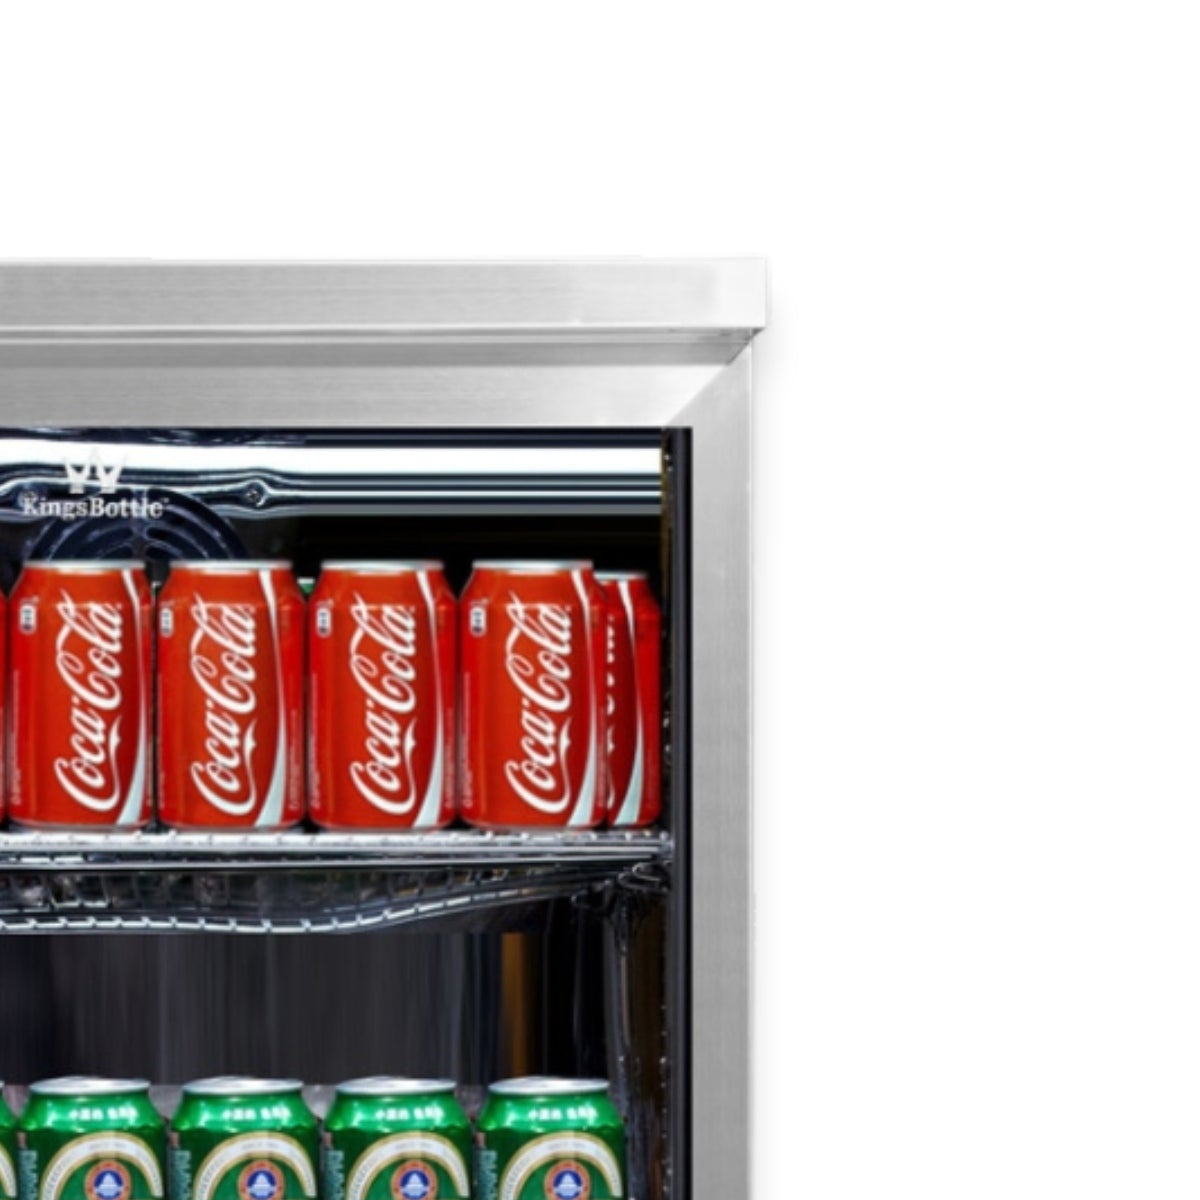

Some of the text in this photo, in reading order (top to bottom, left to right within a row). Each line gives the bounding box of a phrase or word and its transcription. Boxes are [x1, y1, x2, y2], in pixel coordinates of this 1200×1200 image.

[22, 496, 164, 521] KingsBottle
[55, 592, 123, 815] Coca-Cola
[191, 592, 256, 815] Coca-Cola
[350, 592, 416, 815] Coca-Cola
[505, 592, 572, 815] Coca-Cola
